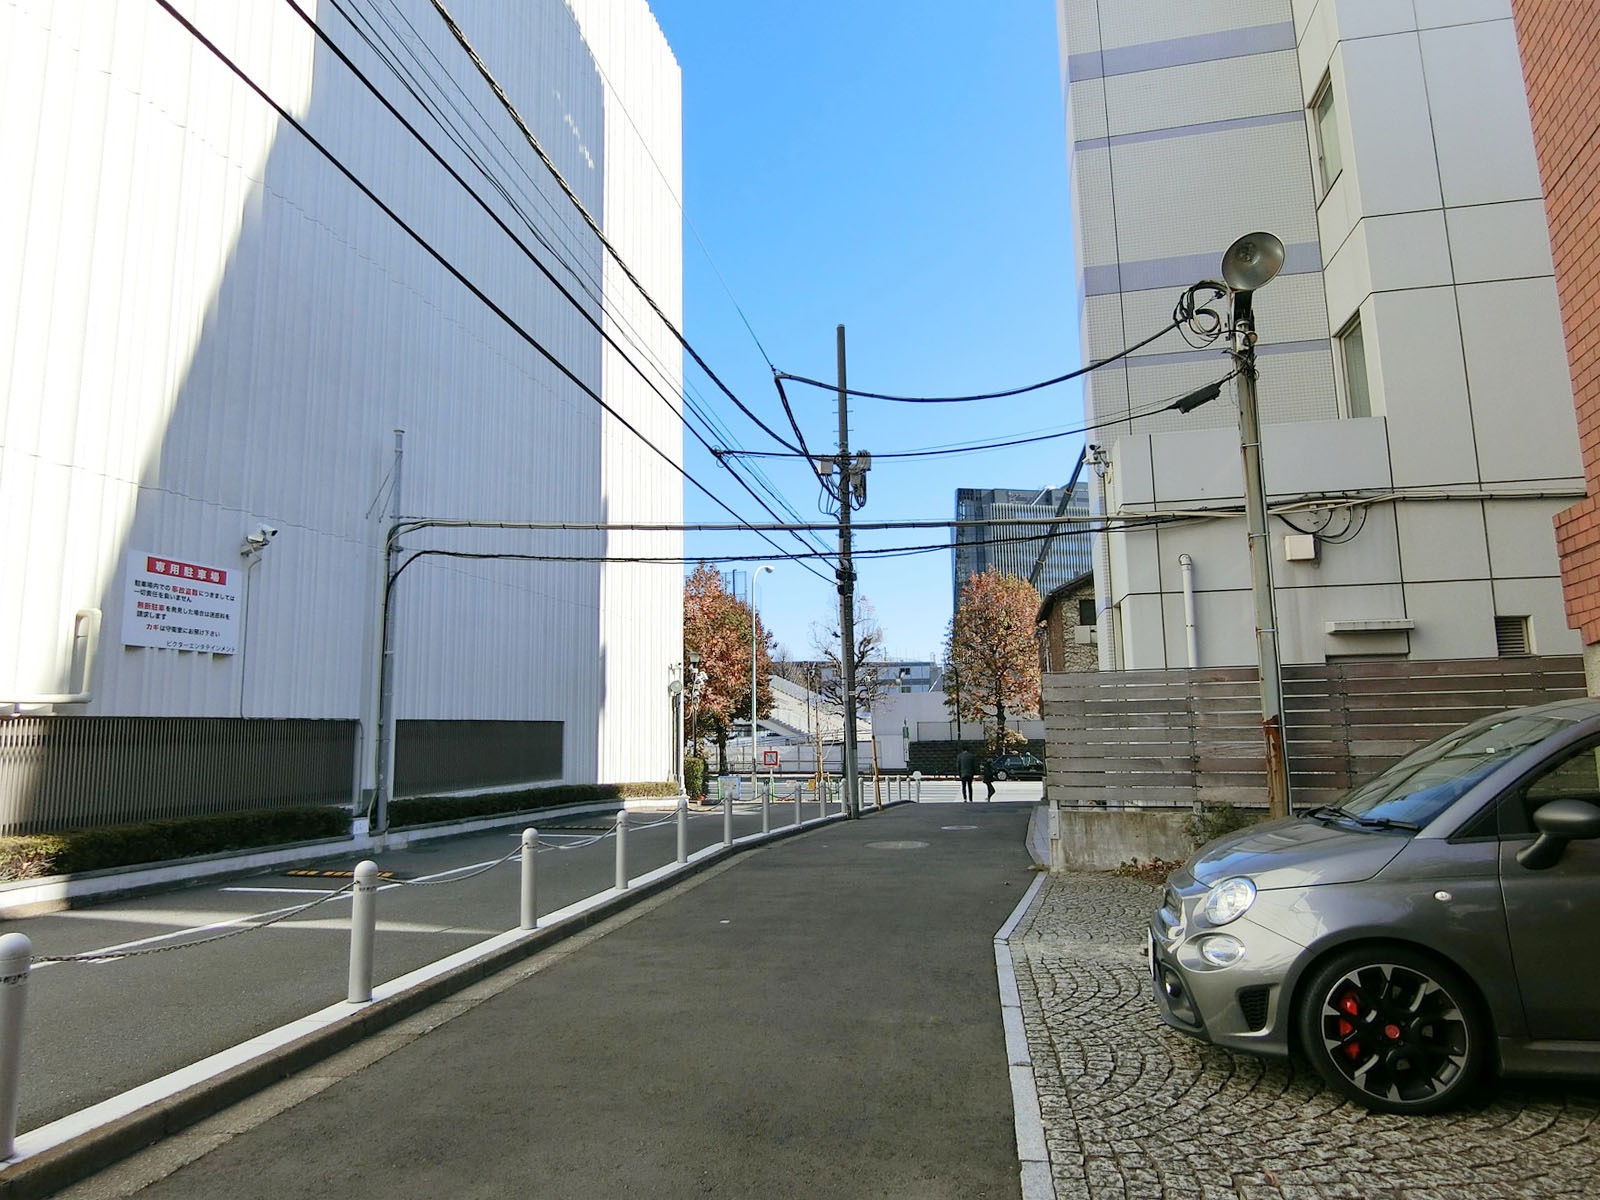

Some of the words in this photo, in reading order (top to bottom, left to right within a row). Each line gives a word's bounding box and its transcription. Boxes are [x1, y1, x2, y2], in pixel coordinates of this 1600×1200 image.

[155, 560, 220, 583] 専用駐車場
[136, 610, 166, 620] 請求します
